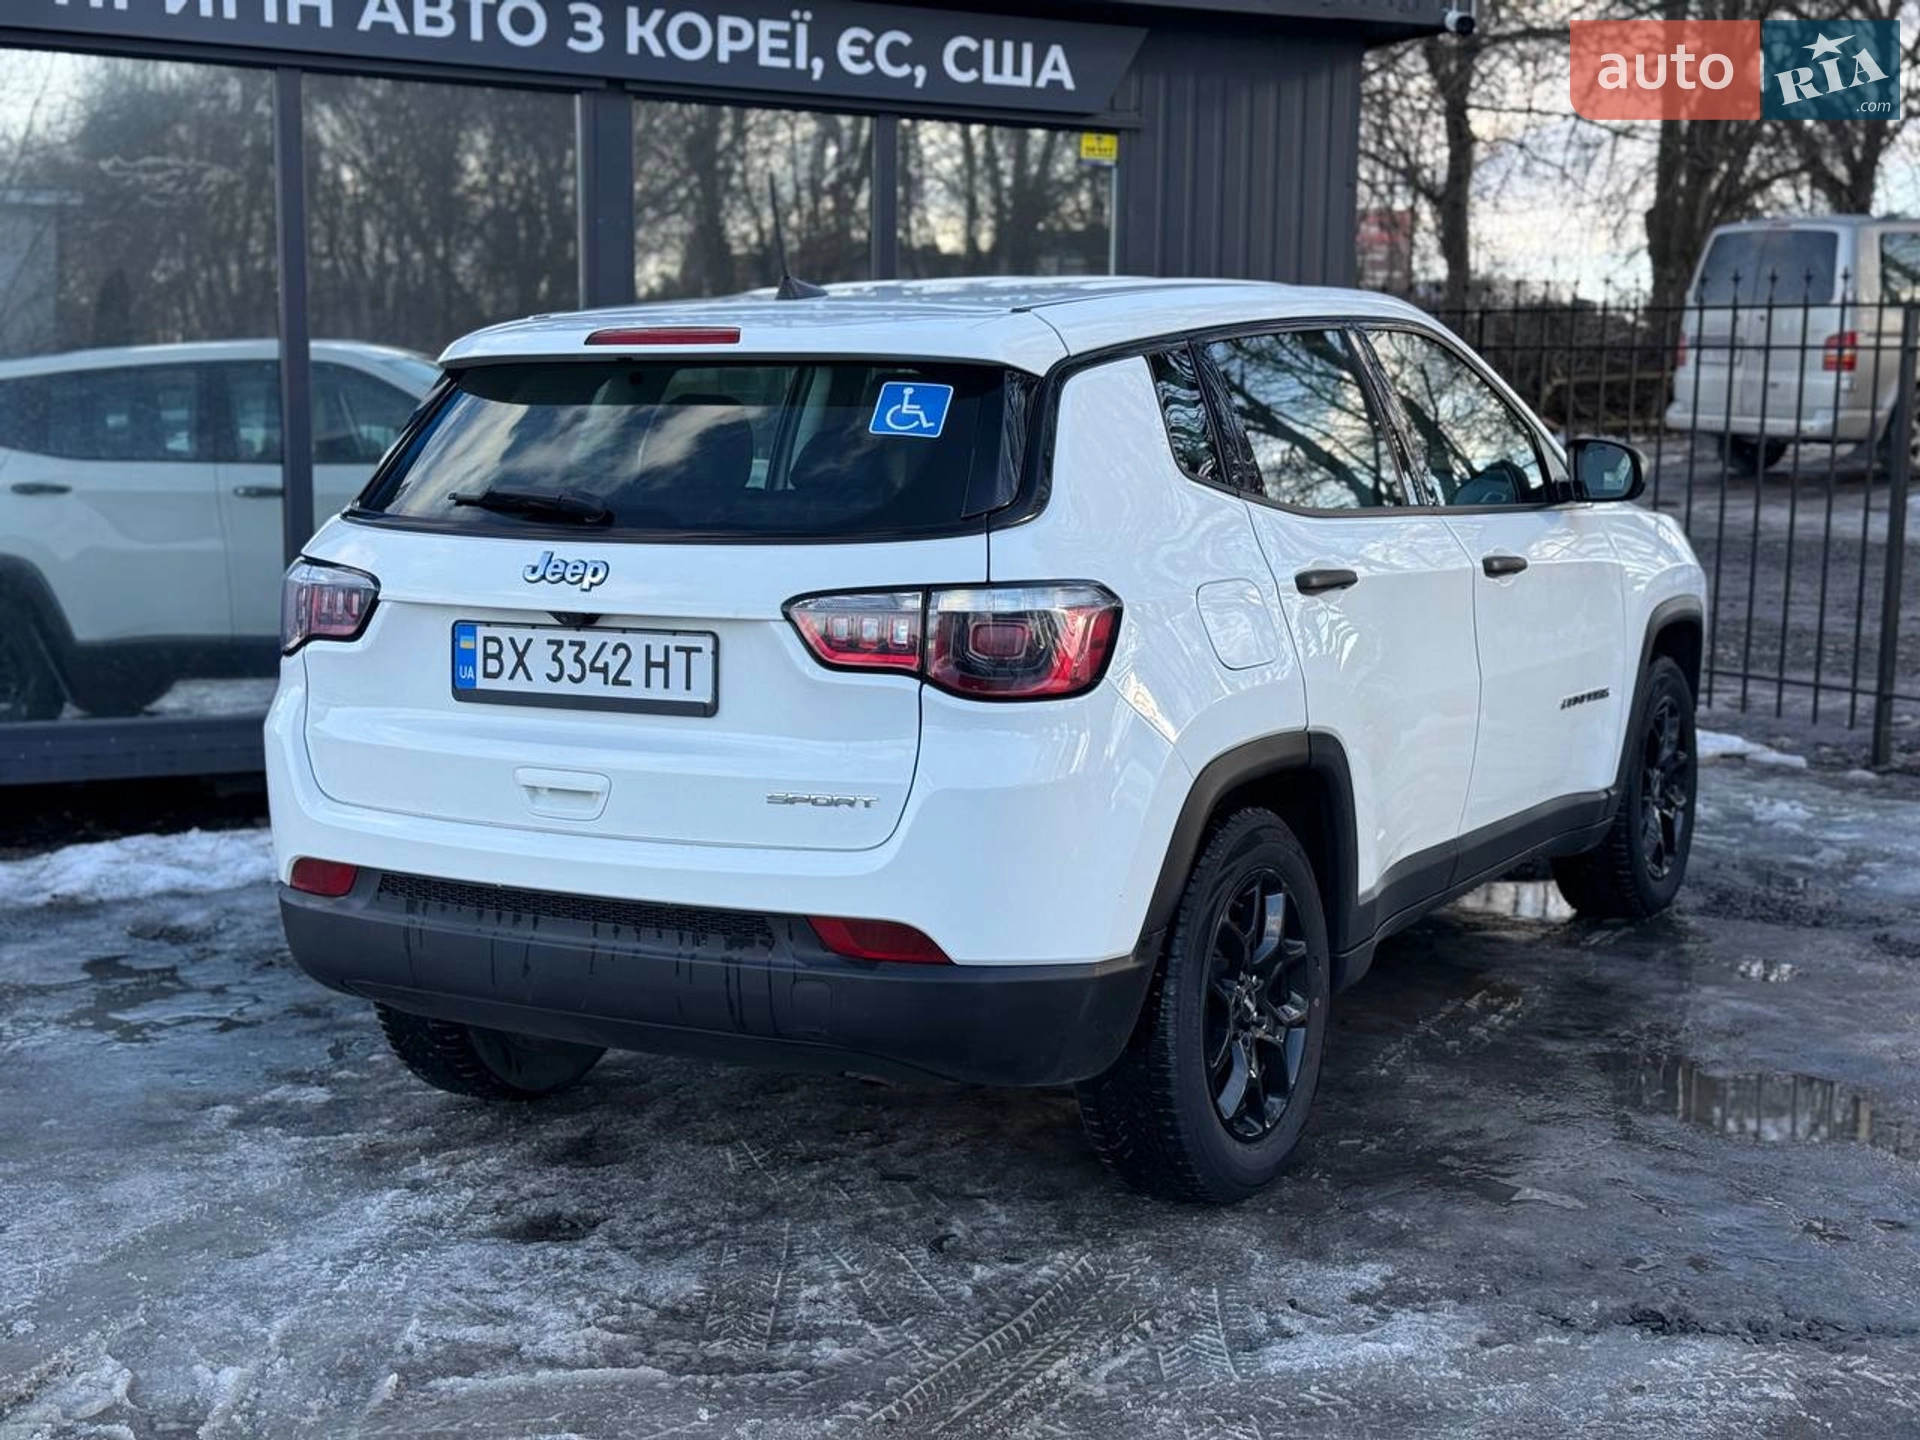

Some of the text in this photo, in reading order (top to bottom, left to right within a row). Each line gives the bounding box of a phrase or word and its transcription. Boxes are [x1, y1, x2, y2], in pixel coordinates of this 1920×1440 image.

[357, 0, 548, 47] АВТО
[566, 2, 605, 53] З
[625, 6, 824, 80] КОРЕЇ,
[836, 26, 927, 88] ЄС,
[942, 36, 1076, 90] США
[522, 551, 610, 591] Jeep
[459, 665, 475, 679] UA
[482, 636, 703, 691] BX 3342 HT
[766, 792, 878, 808] SPORT
